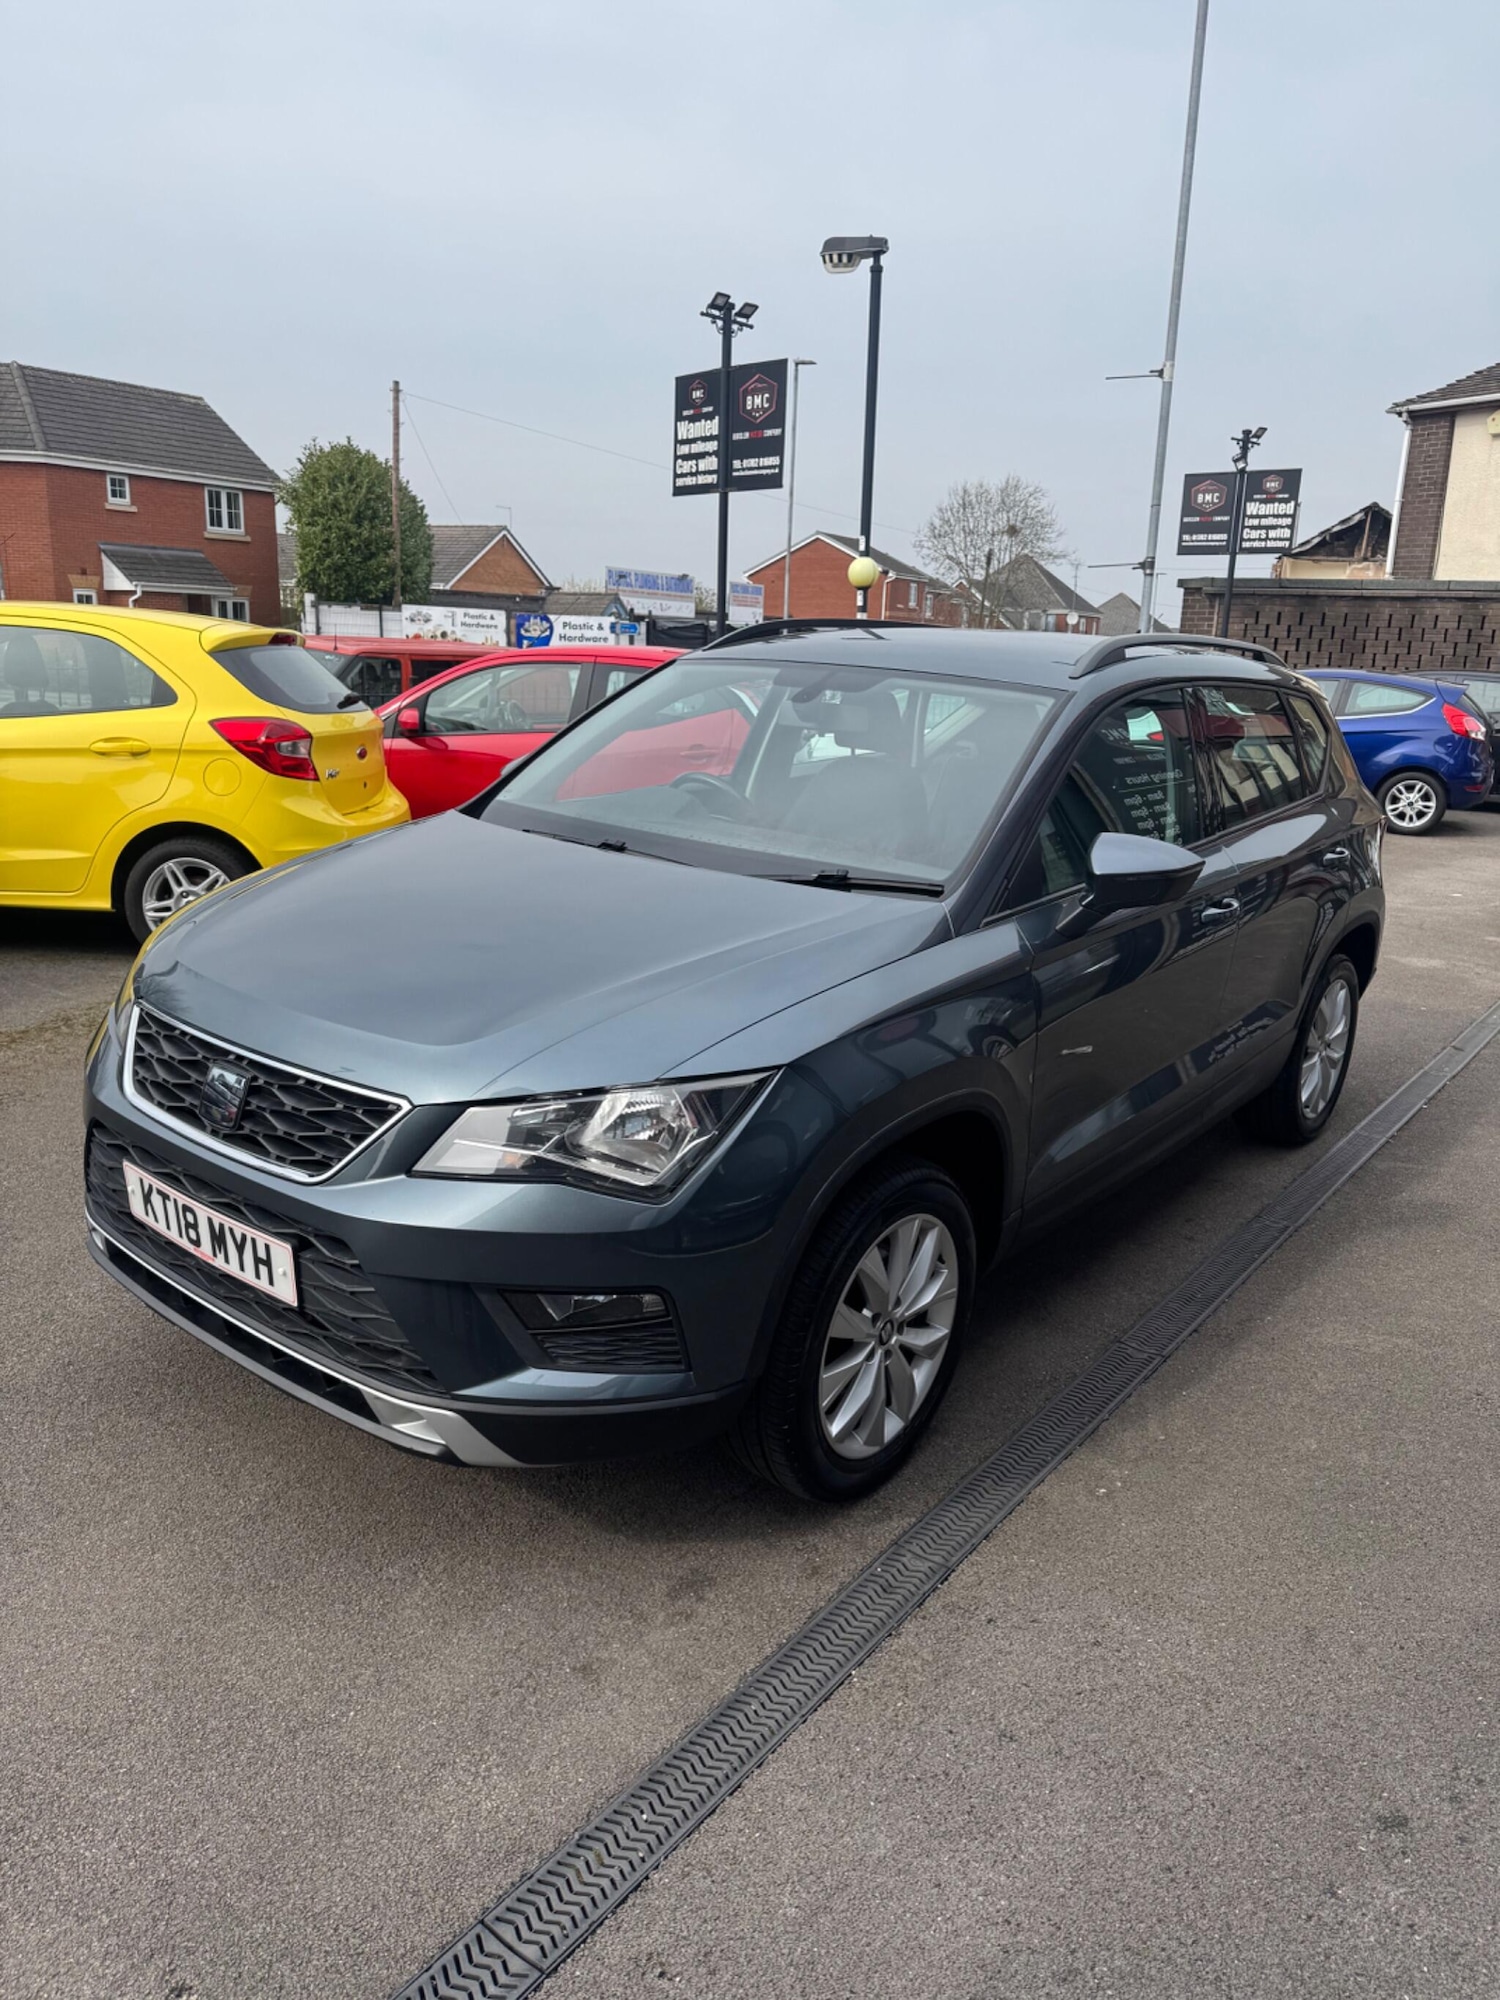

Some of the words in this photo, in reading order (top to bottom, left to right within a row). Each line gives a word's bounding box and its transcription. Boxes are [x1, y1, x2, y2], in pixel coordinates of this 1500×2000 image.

[745, 393, 770, 410] BMC
[676, 415, 719, 441] Wanted
[676, 444, 690, 456] Low
[691, 440, 718, 454] mileage
[675, 459, 697, 474] Cars
[698, 455, 718, 471] with
[675, 476, 696, 487] service
[697, 474, 718, 485] history
[1197, 493, 1220, 504] BMC
[1246, 500, 1295, 515] Wanted
[1244, 517, 1260, 527] Low
[1260, 516, 1292, 527] mileage
[1243, 528, 1267, 539] Cars
[1268, 527, 1291, 539] with
[1241, 540, 1265, 548] service
[1266, 540, 1290, 548] history
[463, 612, 488, 621] Plastic
[460, 621, 499, 630] Hardware
[562, 621, 594, 631] Plastic
[597, 623, 604, 631] &
[559, 633, 609, 643] Hardware
[139, 1177, 202, 1248] KT18
[207, 1215, 274, 1287] MYH
